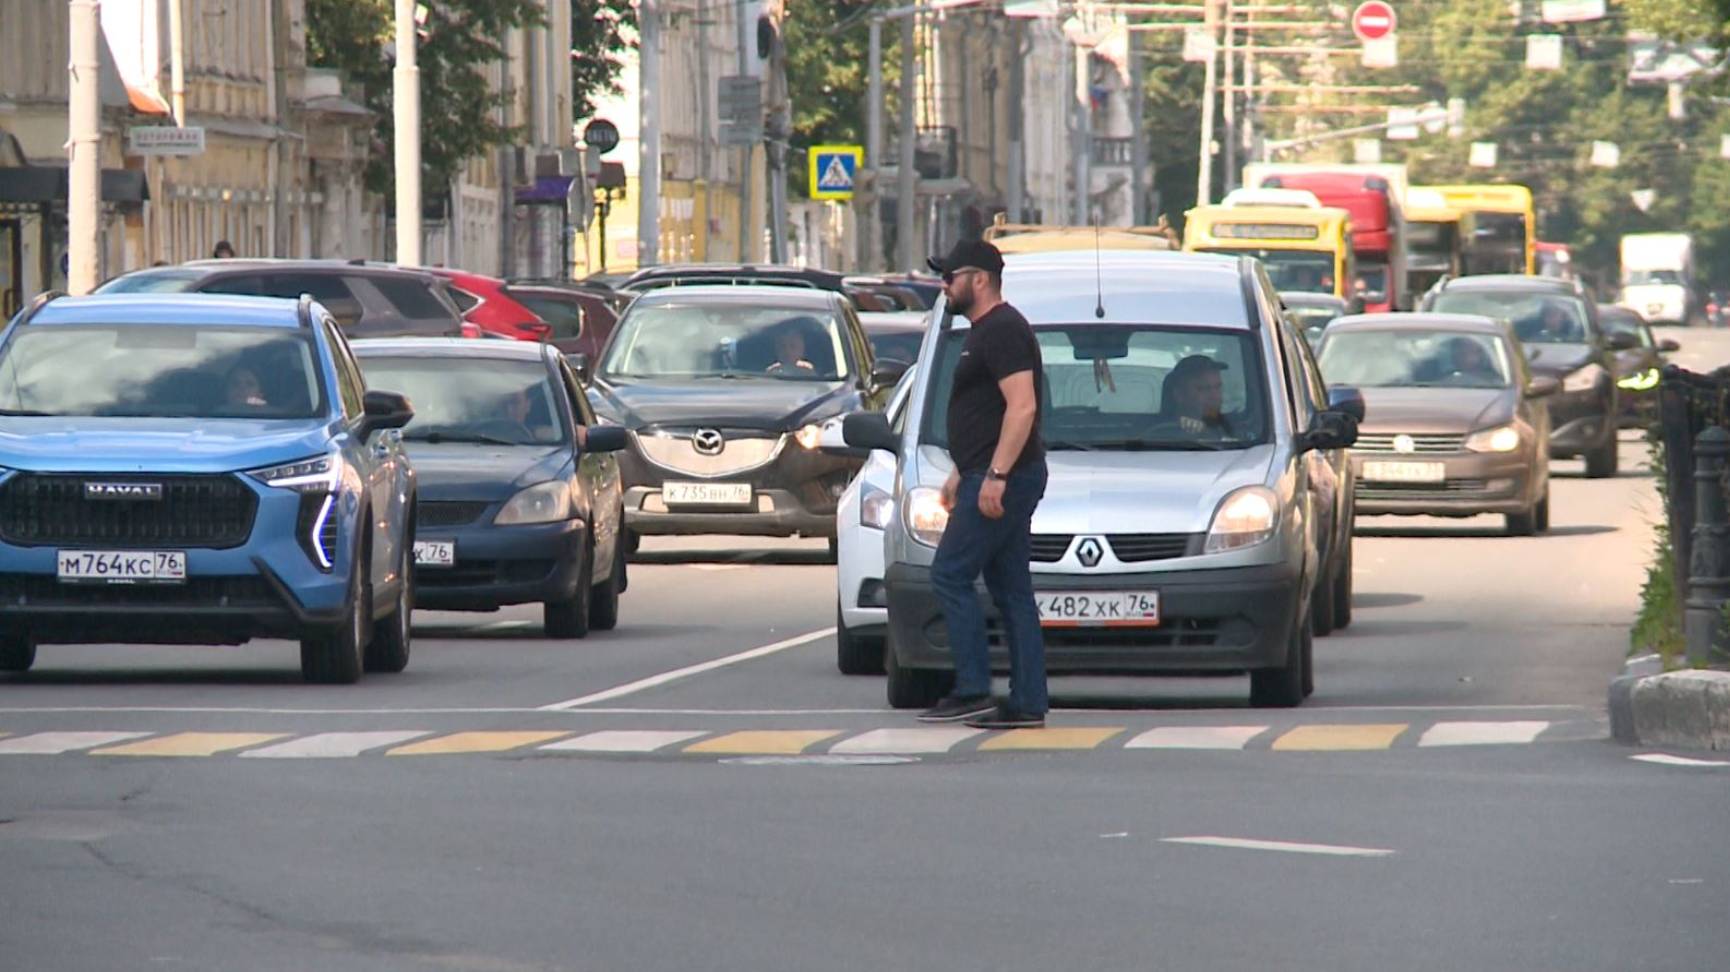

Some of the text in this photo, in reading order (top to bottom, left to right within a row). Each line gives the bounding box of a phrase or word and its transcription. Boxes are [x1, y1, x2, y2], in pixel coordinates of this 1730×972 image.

[65, 554, 178, 574] М764КС 76
[1128, 594, 1149, 611] 76
